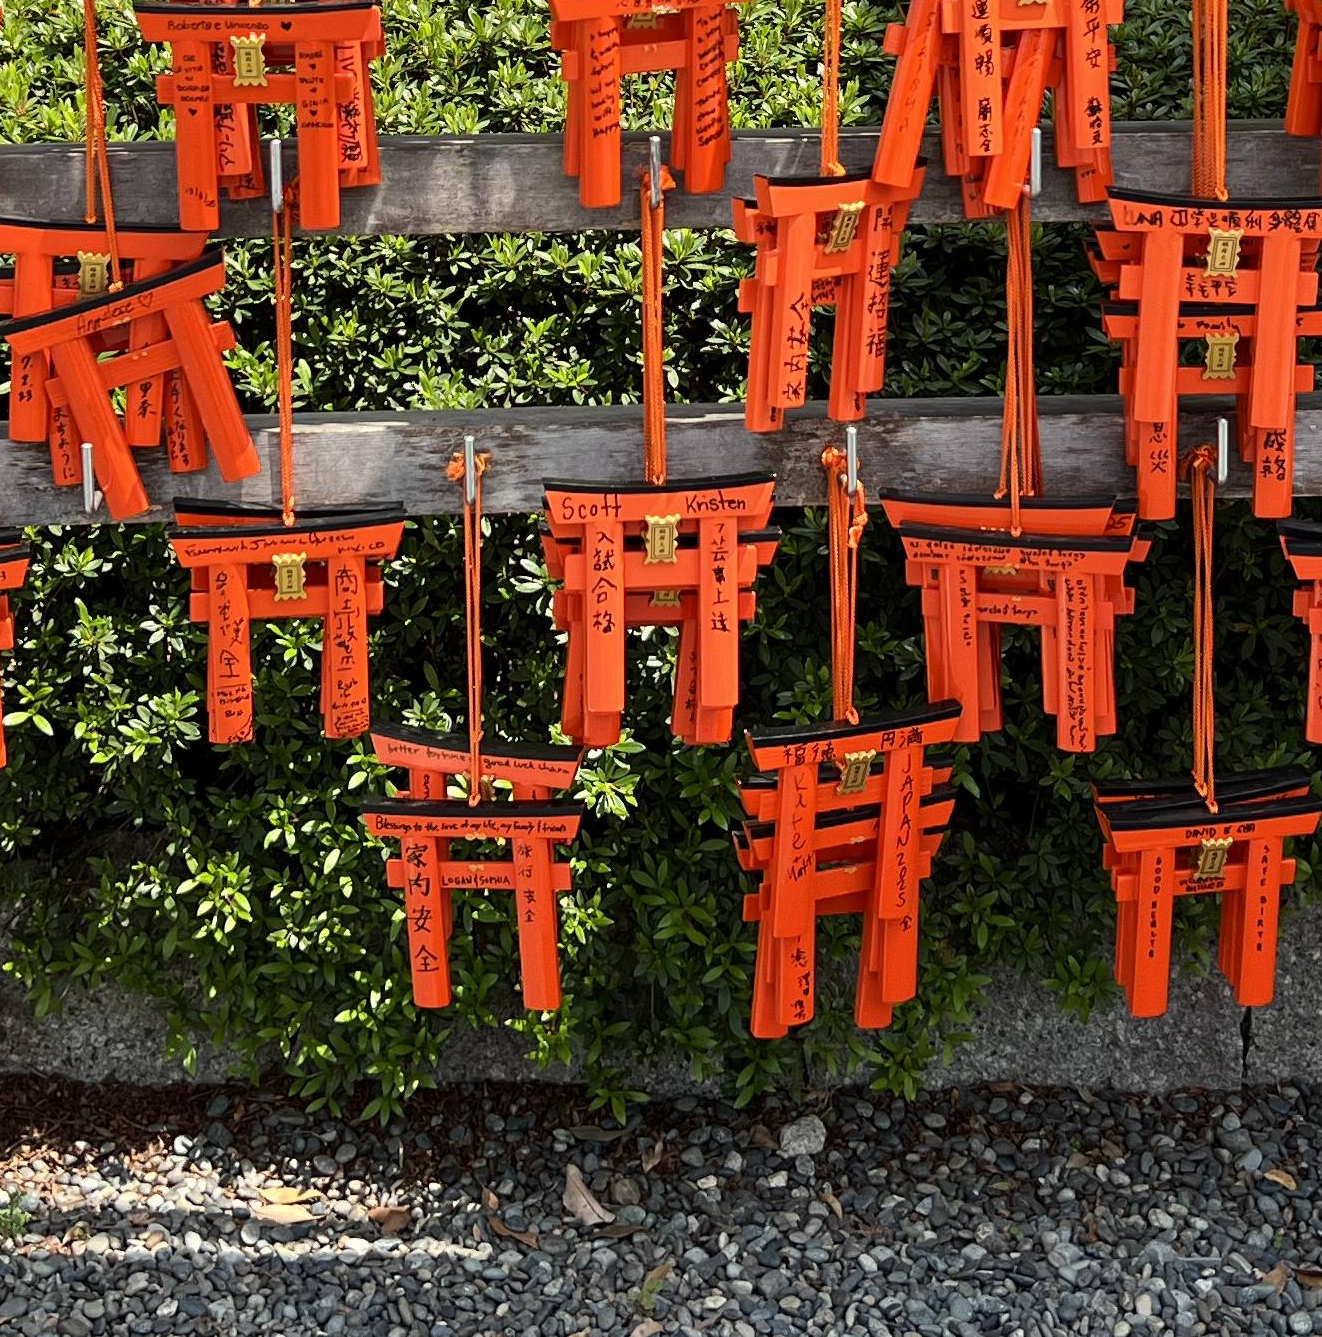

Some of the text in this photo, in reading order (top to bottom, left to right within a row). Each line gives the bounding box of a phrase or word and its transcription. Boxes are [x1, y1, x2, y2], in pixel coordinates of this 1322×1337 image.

[562, 491, 747, 520] Scott Kristen
[405, 842, 440, 973] 家内安全
